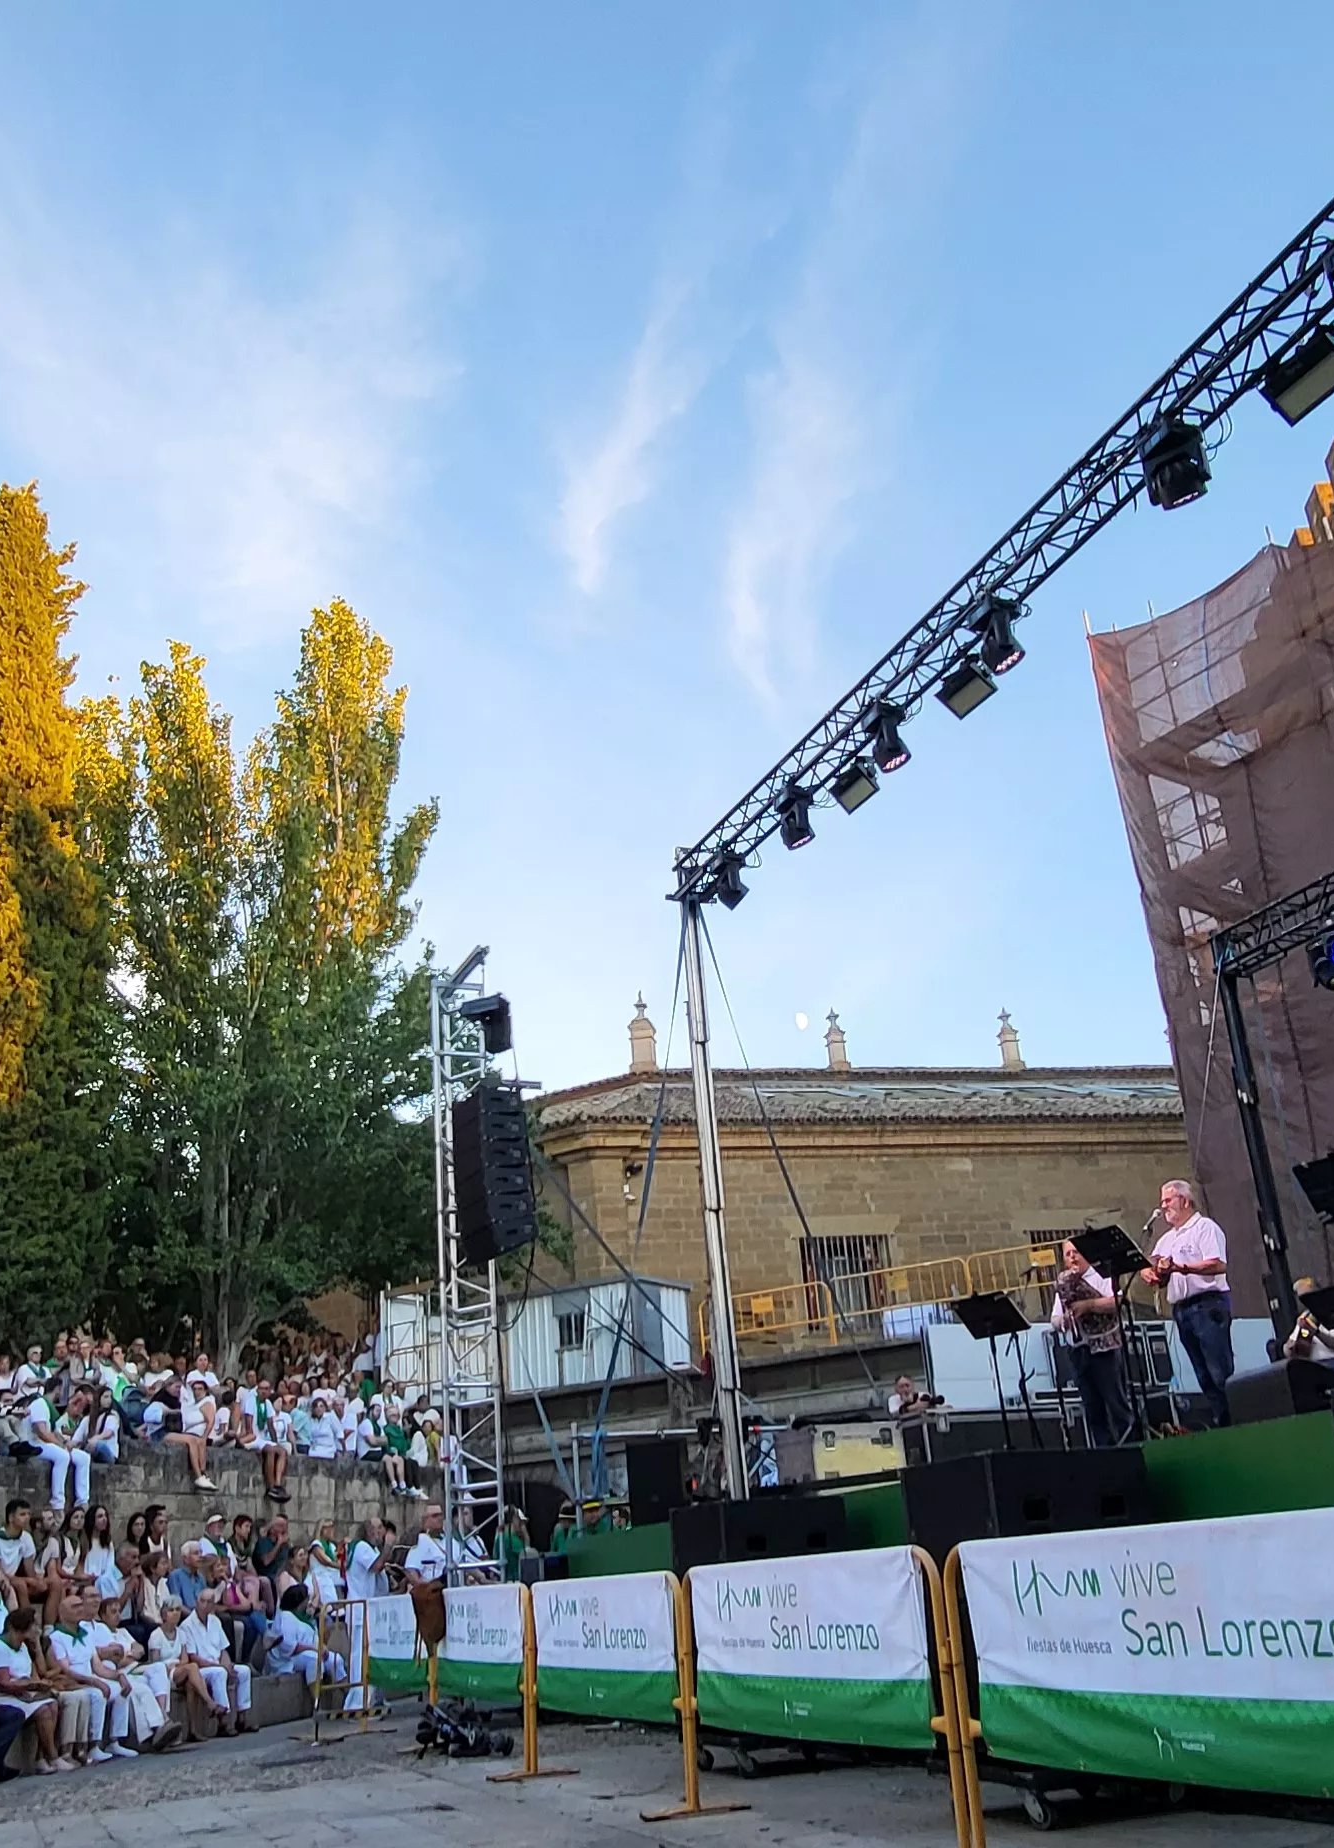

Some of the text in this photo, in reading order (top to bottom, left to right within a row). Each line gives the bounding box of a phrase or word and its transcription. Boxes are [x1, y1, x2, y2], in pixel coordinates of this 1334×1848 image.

[766, 1574, 798, 1608] vive
[1110, 1550, 1177, 1599] vive
[581, 1620, 647, 1650] San Lorenzo
[770, 1614, 880, 1651] San Lorenzo
[1027, 1636, 1112, 1654] fiestas de Huesca
[1121, 1608, 1188, 1658] San
